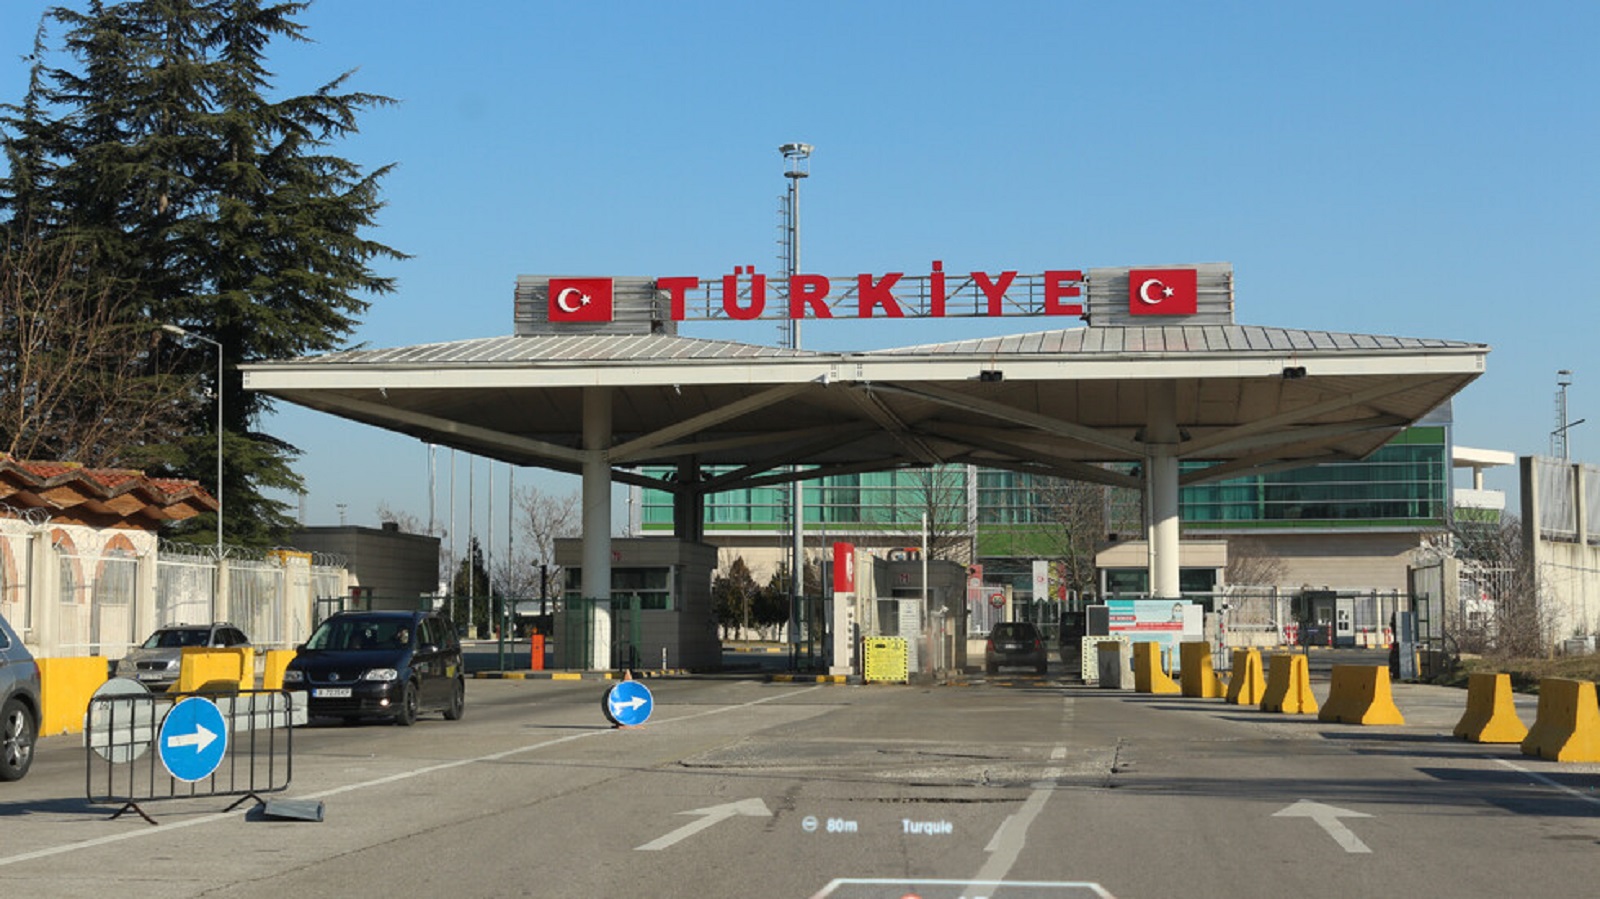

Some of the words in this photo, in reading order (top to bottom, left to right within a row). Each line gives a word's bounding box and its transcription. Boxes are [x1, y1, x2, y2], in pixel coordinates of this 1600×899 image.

[657, 260, 1083, 320] TÜRKİYE
[827, 818, 857, 832] 80m
[902, 818, 953, 835] Turquie
